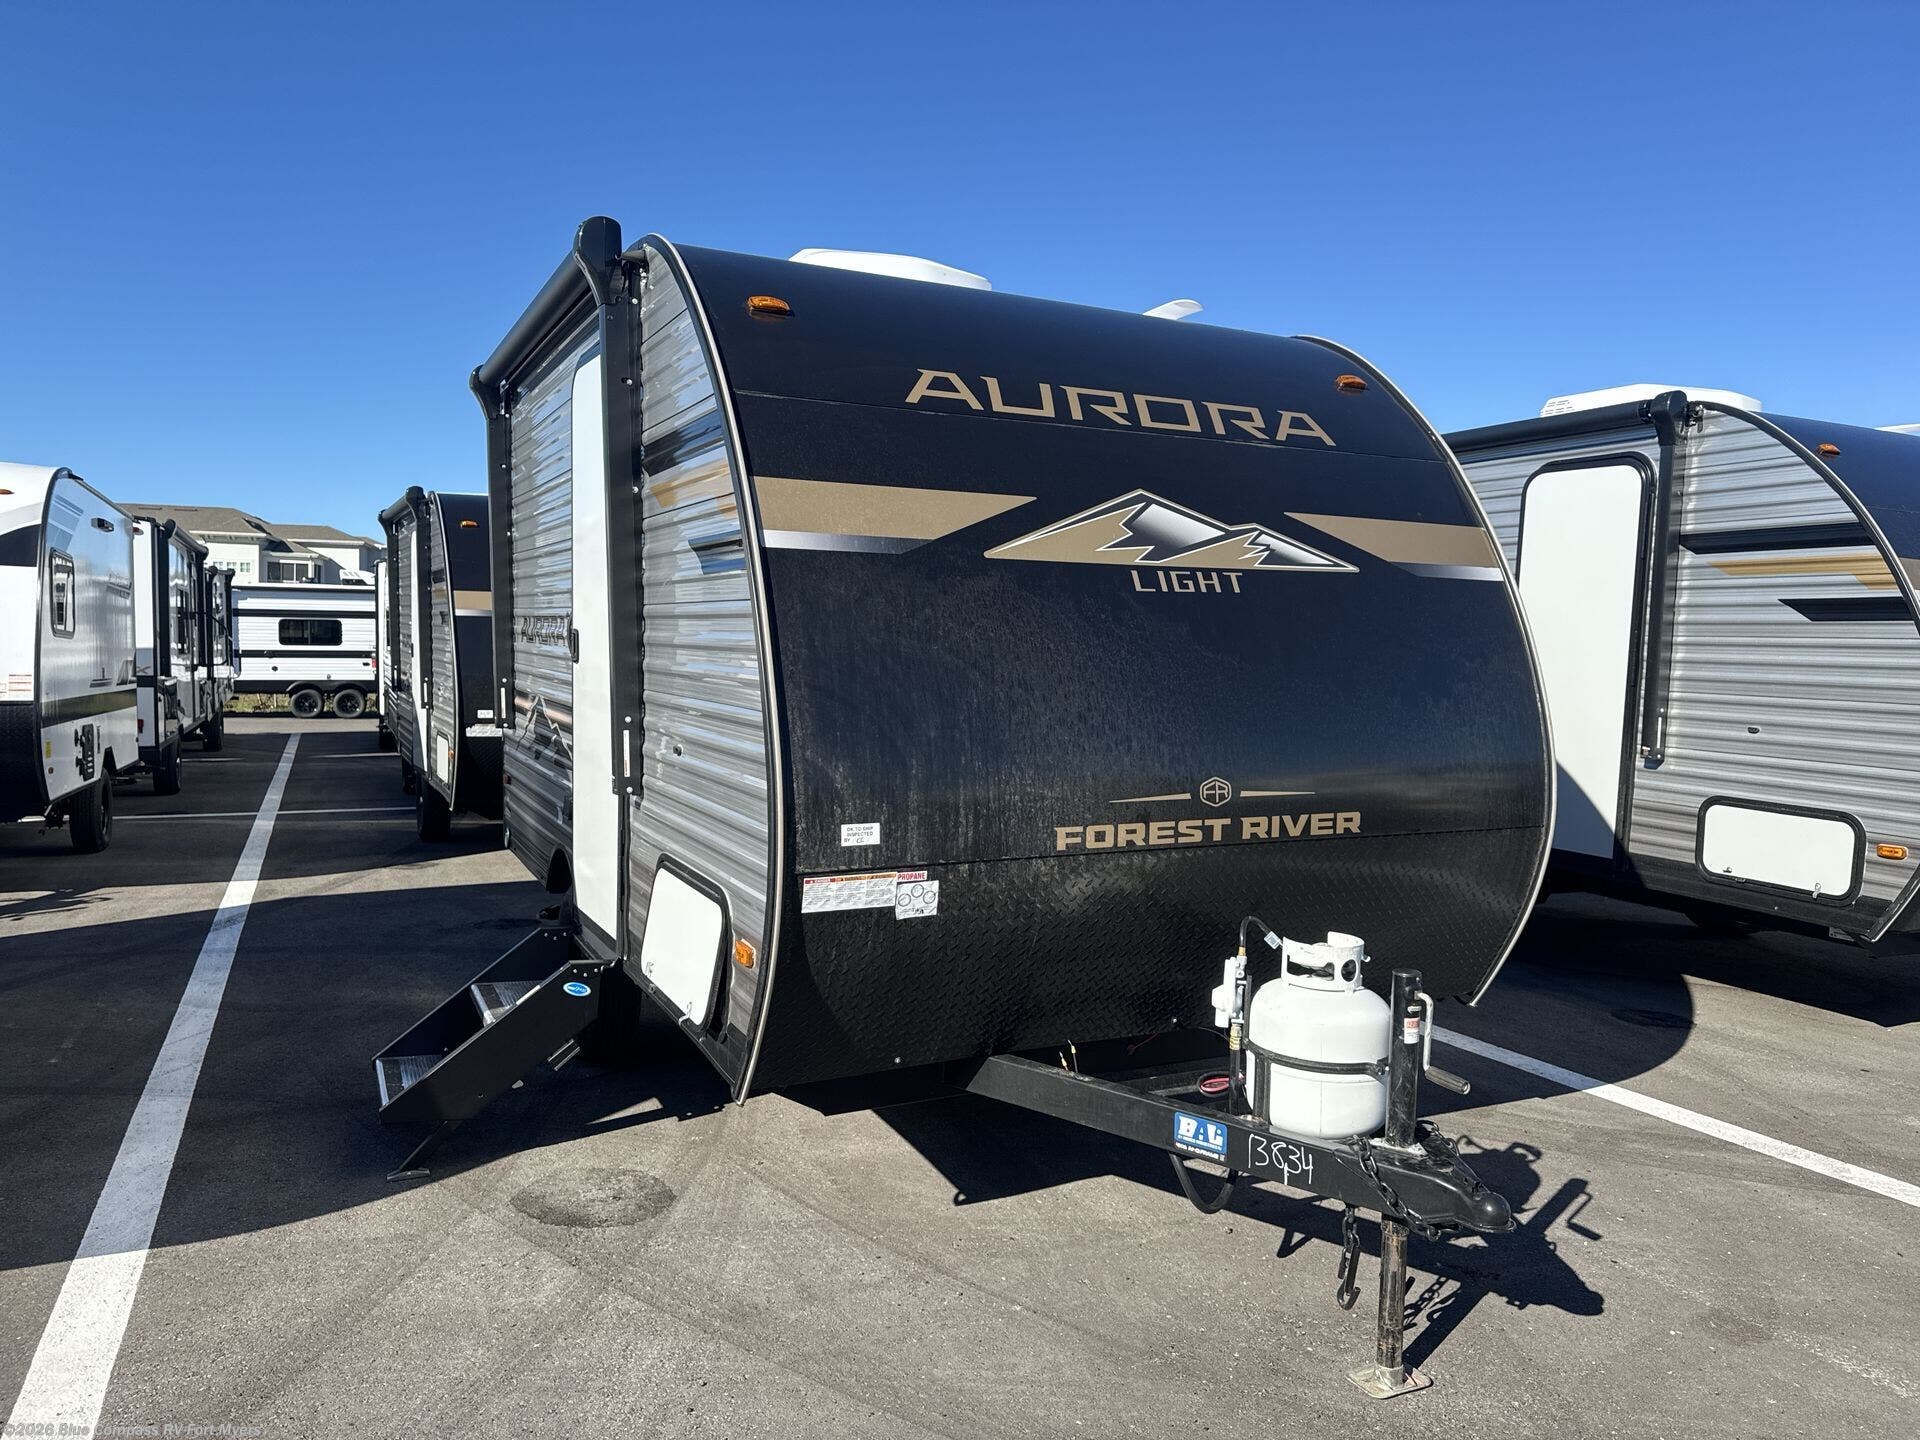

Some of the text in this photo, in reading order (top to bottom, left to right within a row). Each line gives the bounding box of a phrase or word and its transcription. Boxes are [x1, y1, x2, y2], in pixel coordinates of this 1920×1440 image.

[905, 368, 1337, 446] AURORA
[1130, 569, 1243, 593] LIGHT
[1054, 811, 1361, 851] FOREST RIVER
[897, 872, 926, 881] PROPANE
